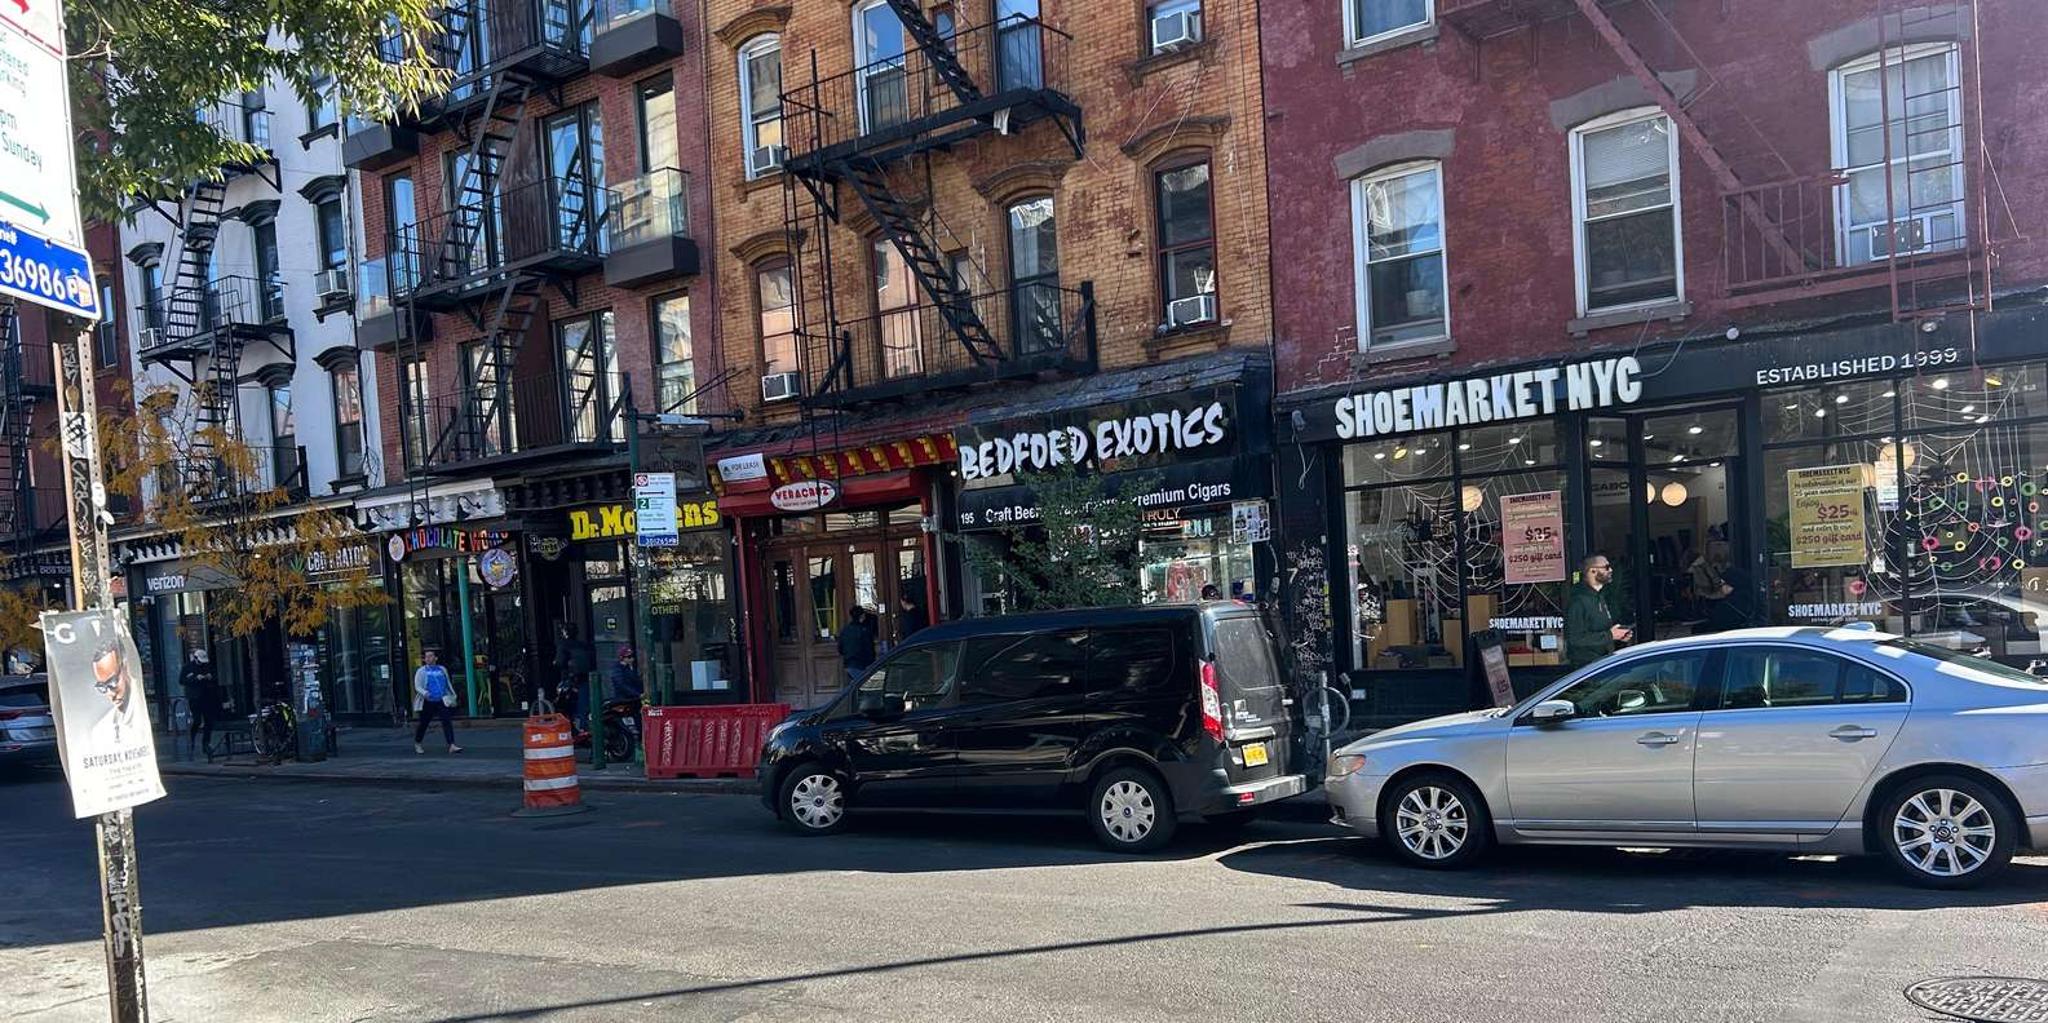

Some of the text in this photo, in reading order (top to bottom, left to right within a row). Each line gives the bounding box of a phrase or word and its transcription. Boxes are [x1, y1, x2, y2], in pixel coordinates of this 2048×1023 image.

[1756, 348, 1957, 385] ESTABLISHED 1999
[1335, 356, 1643, 439] SHOEMARKET NYC
[959, 401, 1224, 480] BEDFORD EXOTICS
[775, 486, 830, 500] VERACRZ
[961, 512, 975, 524] 195
[985, 507, 1012, 522] Craft
[1188, 483, 1231, 501] Cigars
[600, 501, 719, 537] Maens
[1140, 507, 1181, 521] TRULY
[1817, 502, 1849, 522] $25
[405, 526, 467, 553] CHOCOLATE
[330, 545, 370, 568] RATOM
[147, 571, 185, 591] verizon
[651, 604, 680, 615] OTHER
[1788, 602, 1882, 617] SHOEMARKET NYC
[1489, 616, 1564, 630] SHOEMARKET NYC
